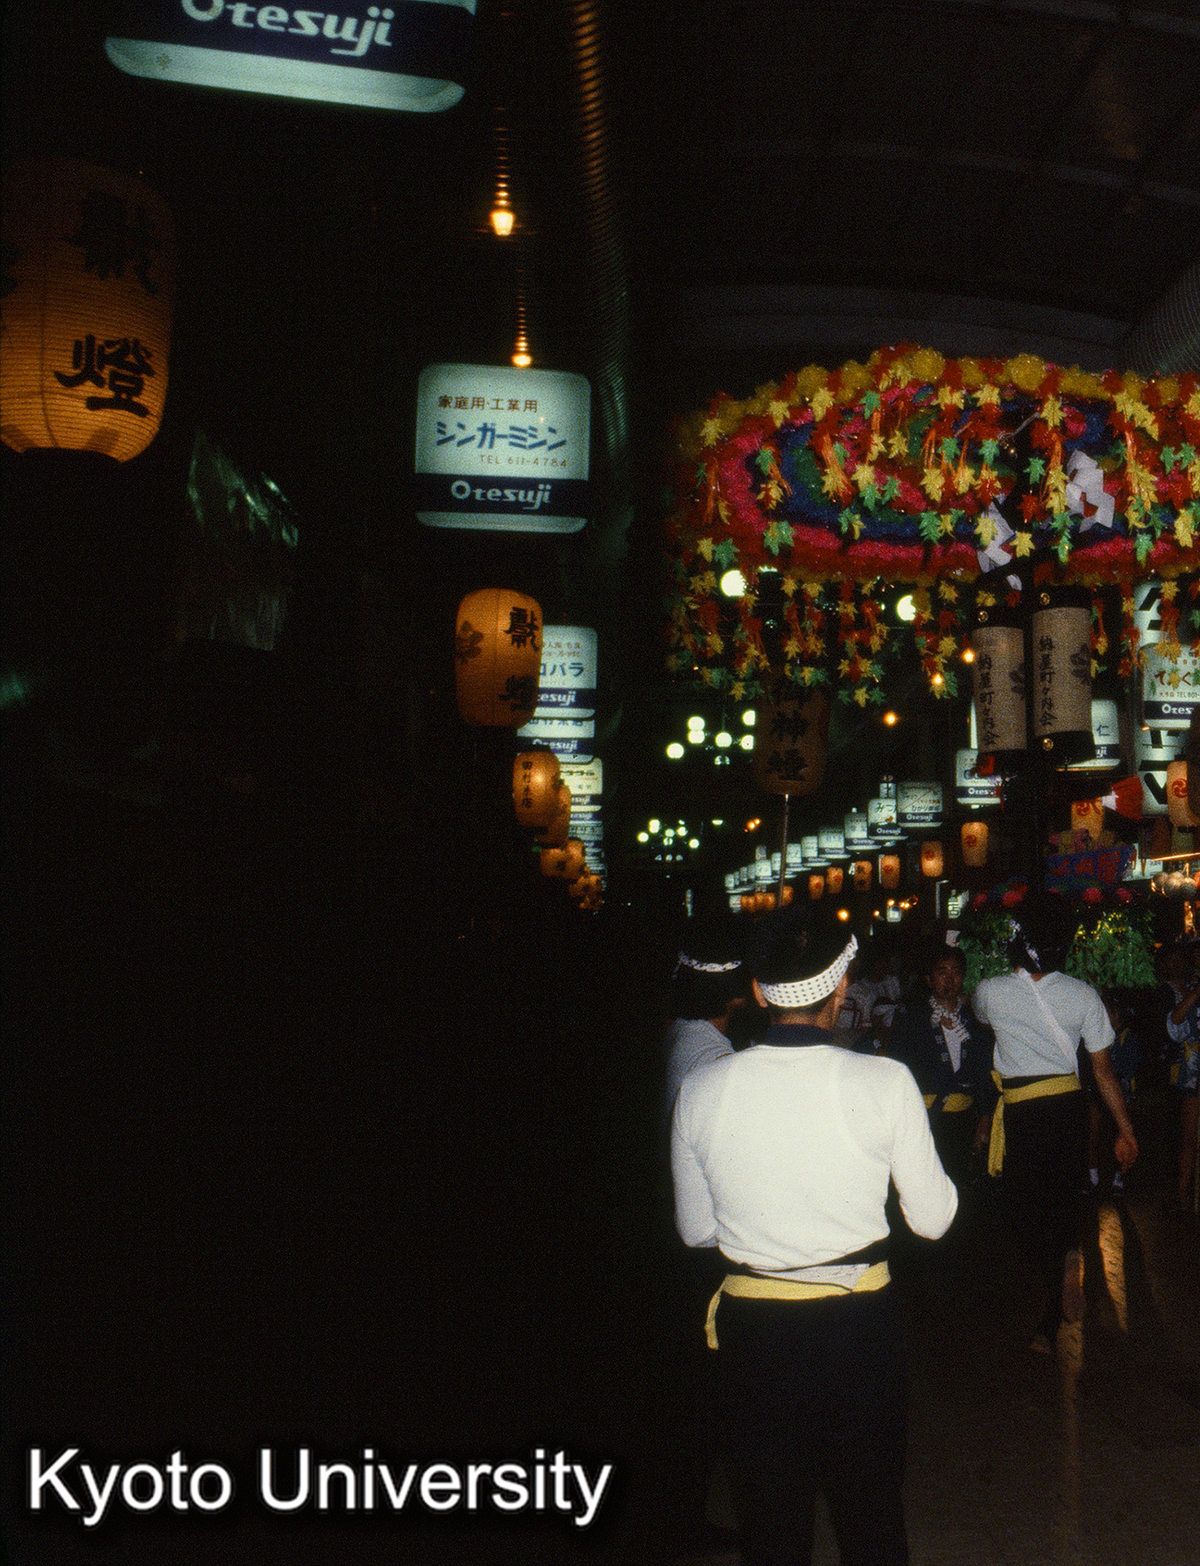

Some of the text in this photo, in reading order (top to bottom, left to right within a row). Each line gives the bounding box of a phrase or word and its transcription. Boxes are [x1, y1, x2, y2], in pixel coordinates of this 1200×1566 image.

[436, 420, 567, 451] シンガーミシン
[480, 453, 501, 465] TEL
[451, 479, 552, 510] Otesuji
